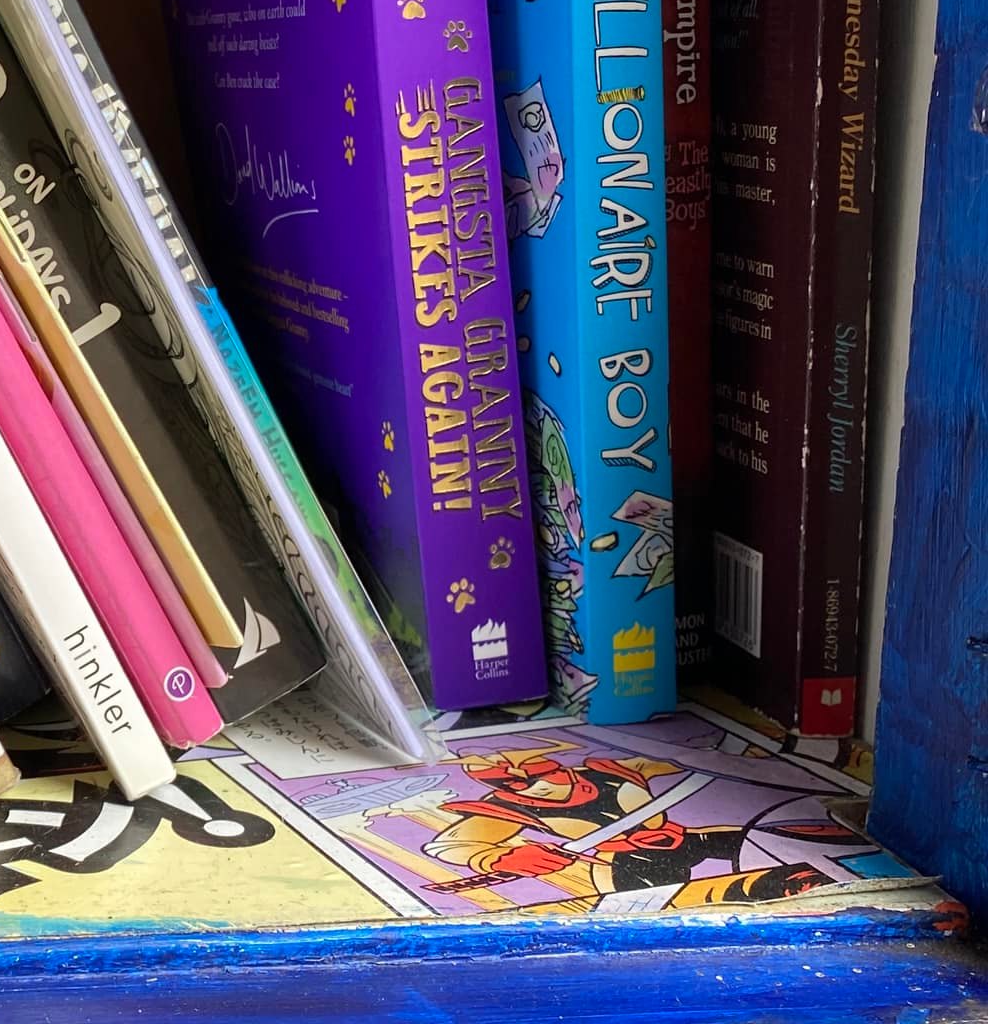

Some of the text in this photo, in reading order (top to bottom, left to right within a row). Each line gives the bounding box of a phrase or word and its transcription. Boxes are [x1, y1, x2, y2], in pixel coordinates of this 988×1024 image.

[267, 0, 284, 20] earth
[742, 121, 777, 145] young
[679, 141, 708, 166] The
[722, 145, 775, 172] woman is
[839, 111, 866, 214] Wizard
[13, 162, 56, 206] ON
[735, 180, 775, 206] master,
[734, 254, 744, 270] to
[746, 259, 774, 279] warn
[397, 106, 473, 511] STRIKES AGAIN!
[443, 76, 524, 523] GANGSTA GRANNY
[743, 282, 774, 311] magic
[725, 315, 772, 340] figures in
[598, 347, 658, 473] BOY
[752, 386, 770, 413] the
[827, 322, 857, 493] Sherryl Jordan
[755, 420, 769, 445] he
[738, 447, 749, 466] to
[750, 447, 768, 475] his
[474, 658, 509, 672] Harper
[474, 667, 509, 681] Collins
[62, 624, 132, 737] hinkler
